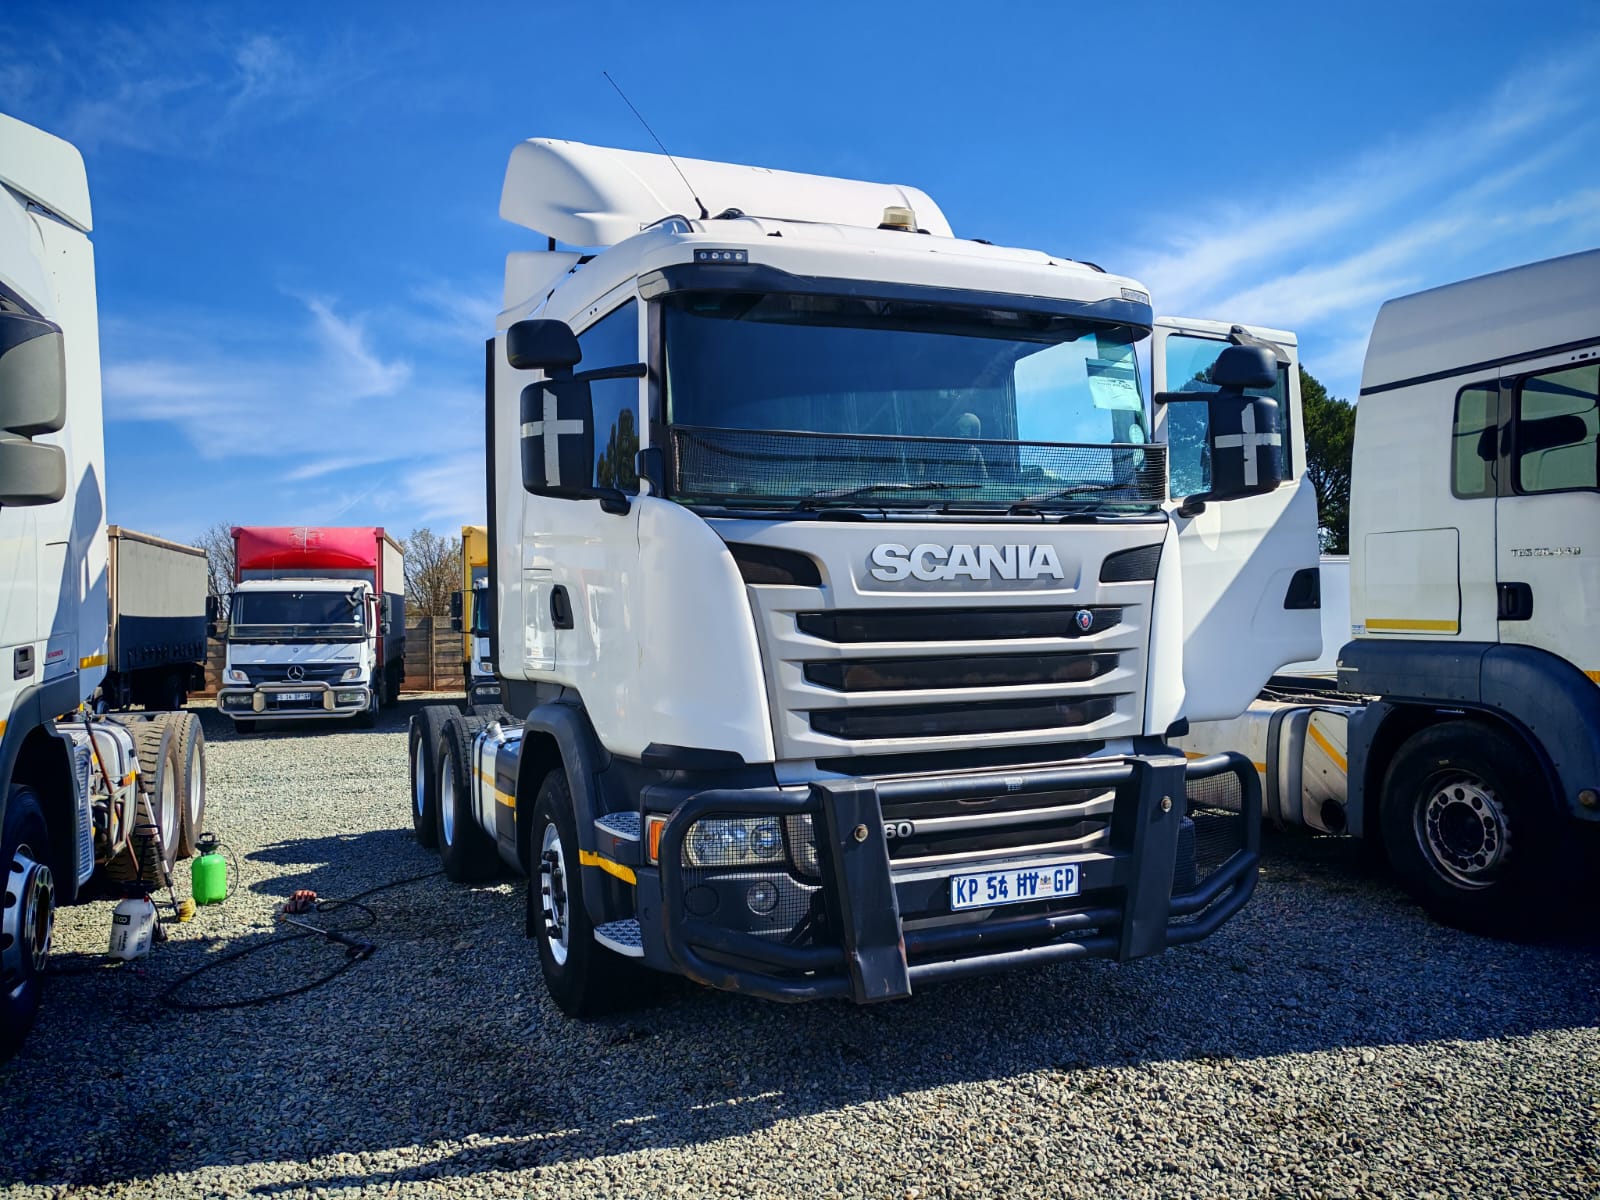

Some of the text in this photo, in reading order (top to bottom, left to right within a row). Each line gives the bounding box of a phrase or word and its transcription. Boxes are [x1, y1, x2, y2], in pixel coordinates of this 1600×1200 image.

[871, 543, 1065, 581] SCANIA
[956, 878, 979, 904] KP
[986, 874, 1009, 901] 54
[1054, 868, 1075, 892] GP
